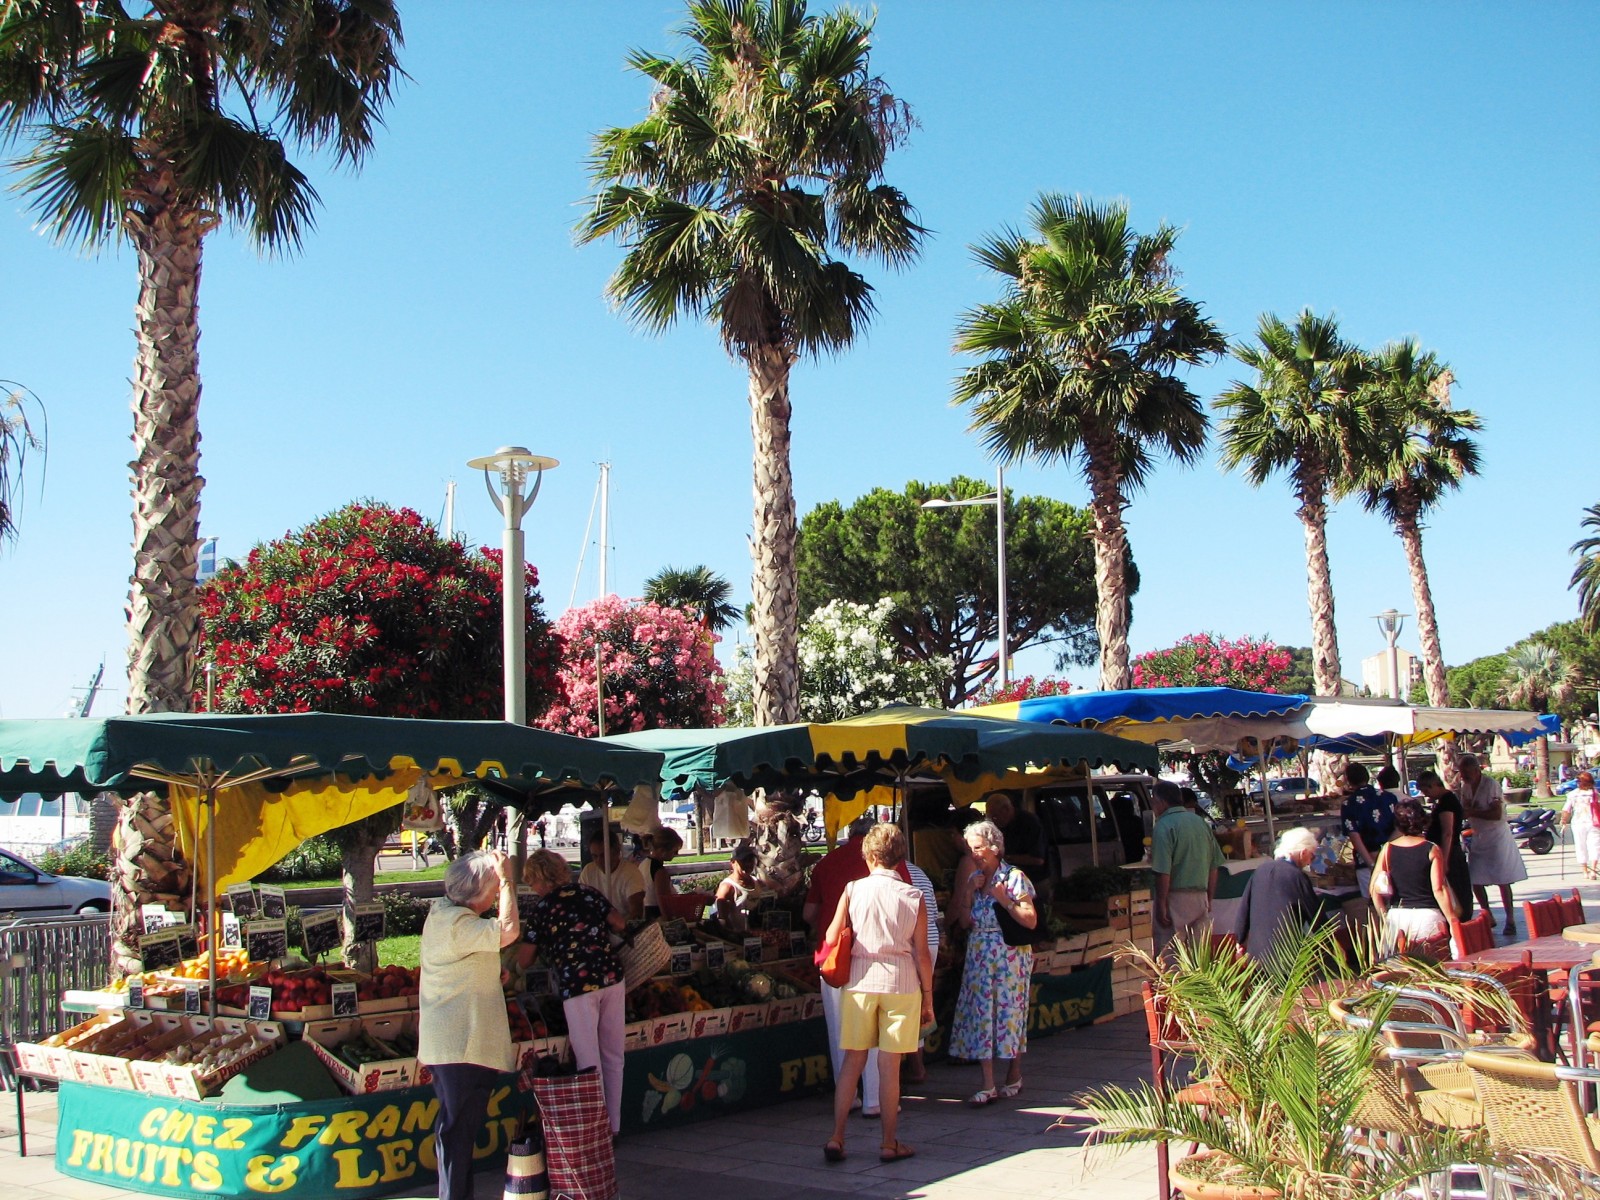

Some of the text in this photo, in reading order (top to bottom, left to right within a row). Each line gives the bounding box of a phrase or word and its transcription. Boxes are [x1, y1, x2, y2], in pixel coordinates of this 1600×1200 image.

[220, 1044, 273, 1079] PROVENCE
[311, 1043, 350, 1080] PROVENCE
[140, 1086, 511, 1149] CHEZ FRANY
[67, 1129, 224, 1191] FRUITS
[245, 1154, 300, 1193] &
